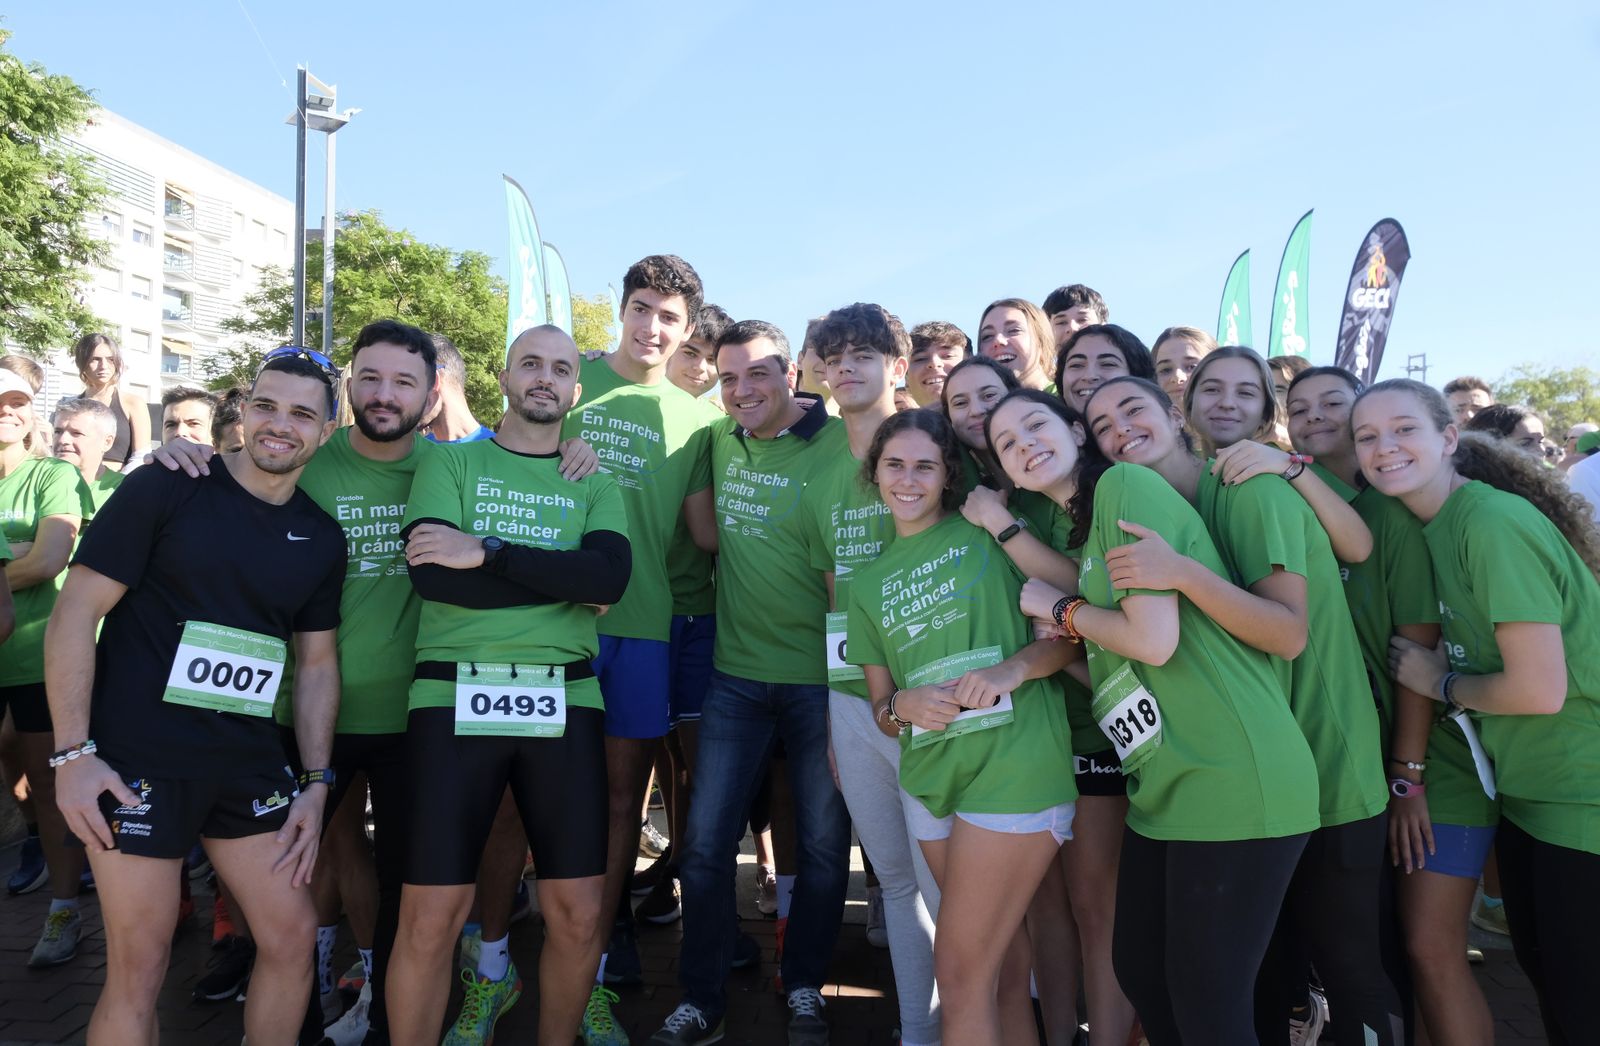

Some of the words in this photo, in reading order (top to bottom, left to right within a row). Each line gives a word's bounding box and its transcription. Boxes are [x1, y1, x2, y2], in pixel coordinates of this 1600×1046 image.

[582, 410, 603, 426] En
[608, 417, 660, 443] marcha
[580, 429, 630, 448] contra
[597, 446, 647, 468] cáncer
[726, 463, 738, 478] En
[740, 468, 789, 487] marcha
[336, 494, 364, 502] Córdoba
[476, 483, 501, 498] En
[507, 489, 575, 510] marcha
[722, 480, 755, 497] contra
[337, 504, 363, 520] En
[369, 503, 407, 518] mar
[475, 502, 536, 519] contra
[717, 494, 727, 507] el
[727, 498, 771, 517] cáncer
[831, 511, 840, 527] E
[844, 501, 891, 521] marcha
[473, 516, 491, 531] el
[496, 519, 562, 540] cáncer
[834, 525, 866, 542] ntra
[361, 538, 405, 554] cánc
[882, 579, 903, 597] En
[882, 608, 896, 628] el
[900, 577, 956, 617] cáncer
[187, 657, 273, 694] 0007
[470, 693, 557, 717] 0493
[1109, 699, 1156, 749] 0318
